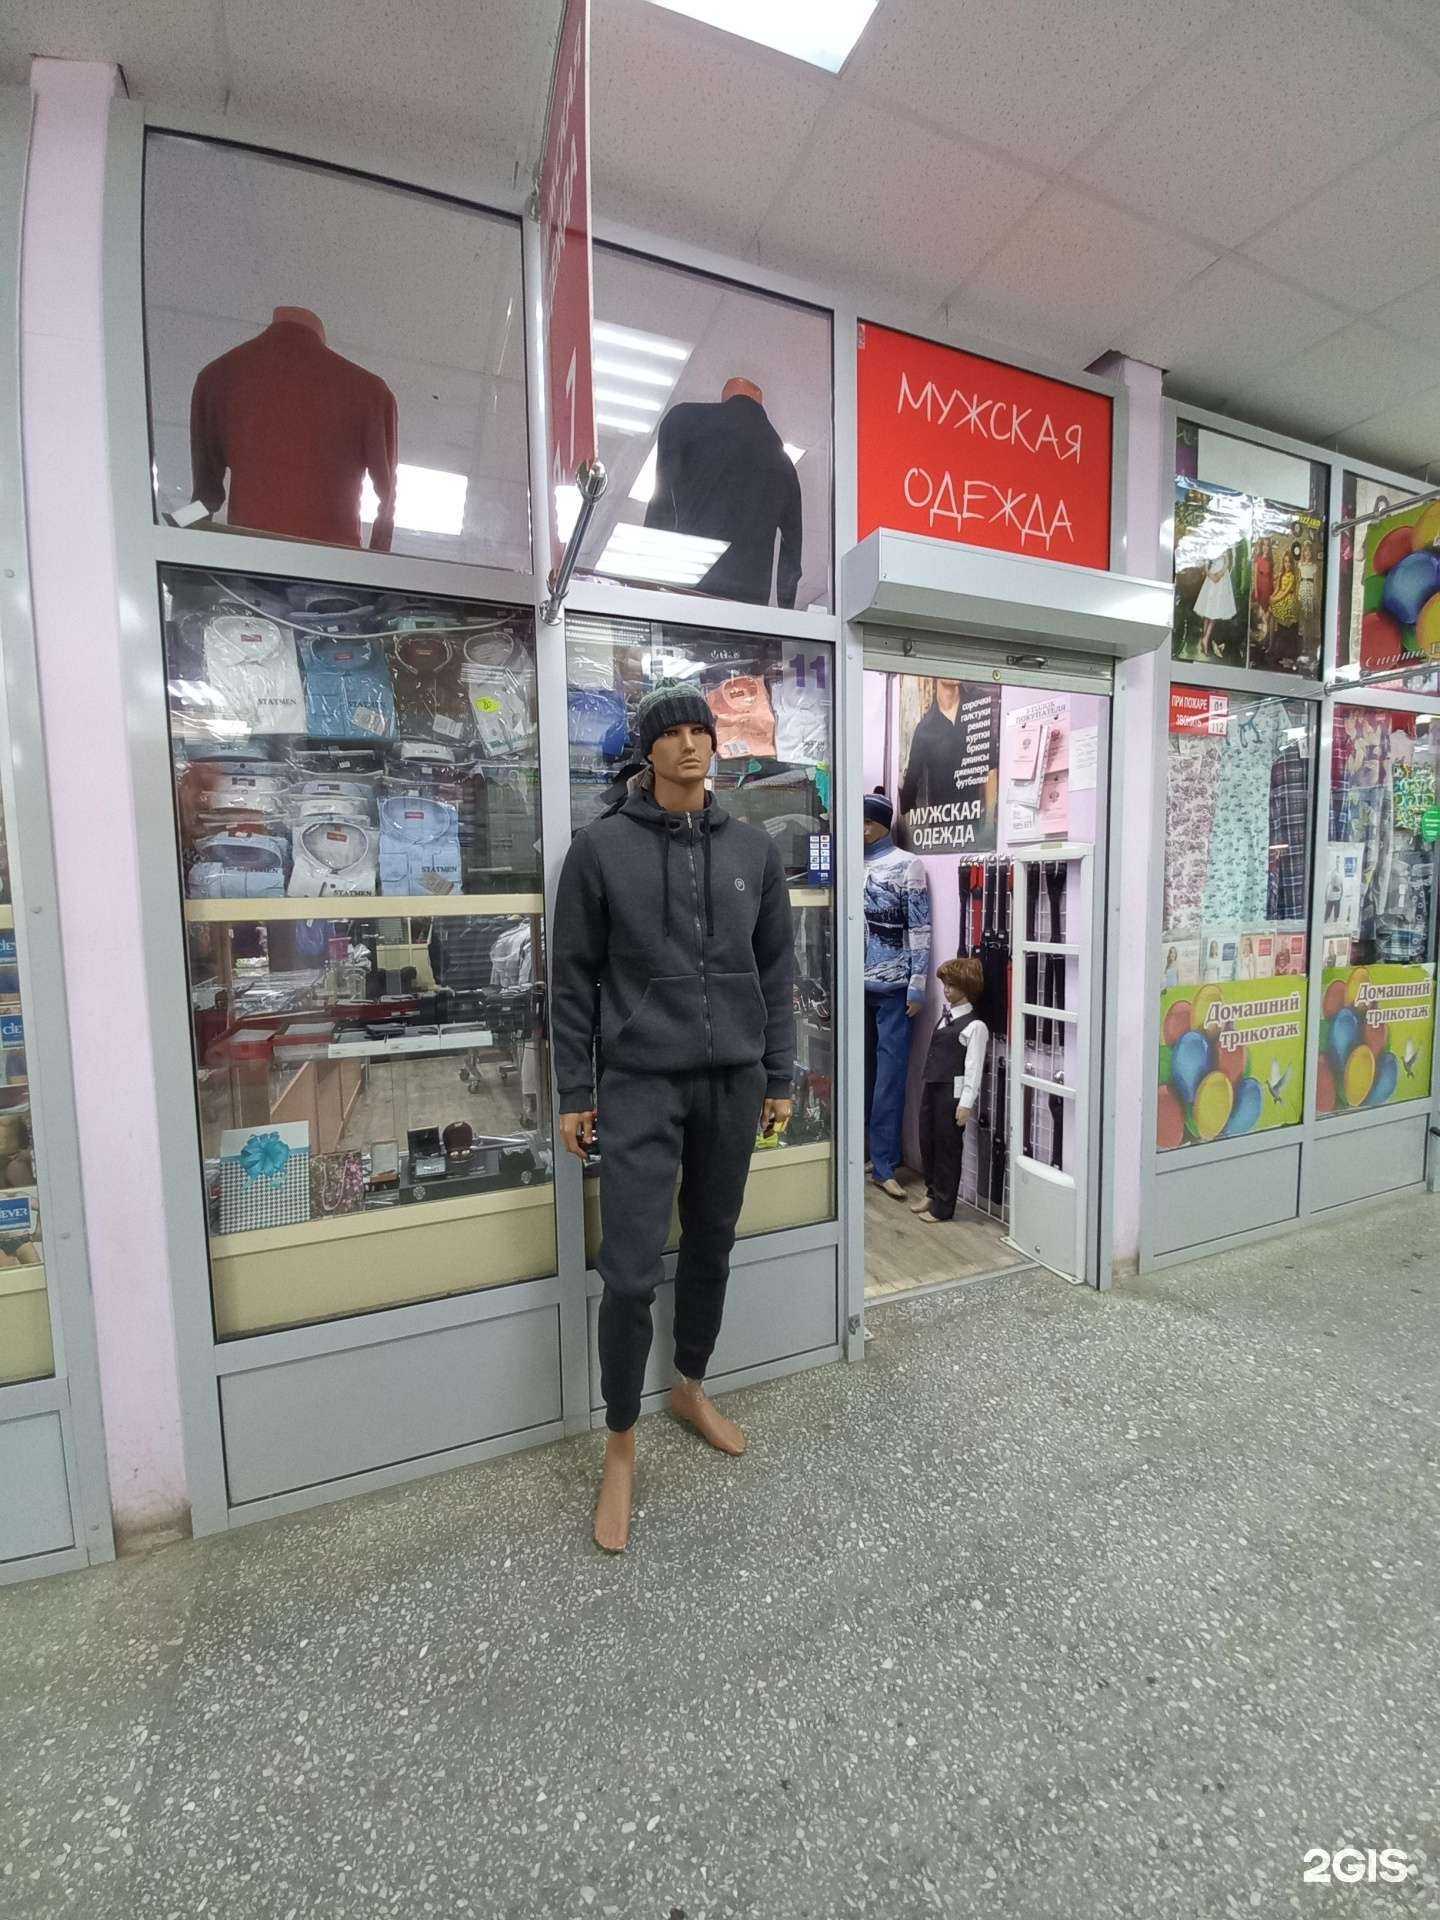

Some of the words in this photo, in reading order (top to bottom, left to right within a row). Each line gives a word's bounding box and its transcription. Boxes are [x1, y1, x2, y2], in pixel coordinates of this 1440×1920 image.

[898, 372, 1082, 464] МУЖСКАЯ
[903, 467, 1074, 551] ОДЕЖДА
[789, 653, 825, 688] 11
[962, 696, 992, 711] сорочки
[960, 708, 991, 723] галстуки
[966, 730, 991, 746] куртки
[966, 742, 990, 755] брюки
[960, 753, 990, 768] джинсы
[953, 765, 989, 780] джемпера
[955, 776, 989, 790] футболки
[909, 800, 981, 826] МУЖСКАЯ
[913, 824, 975, 849] ОДЕЖДА
[421, 865, 457, 873] STATMEN
[1357, 980, 1432, 1003] Домашний
[1205, 993, 1301, 1024] Домашний
[1366, 1006, 1430, 1026] трикотаж
[1219, 1024, 1299, 1051] трикотаж
